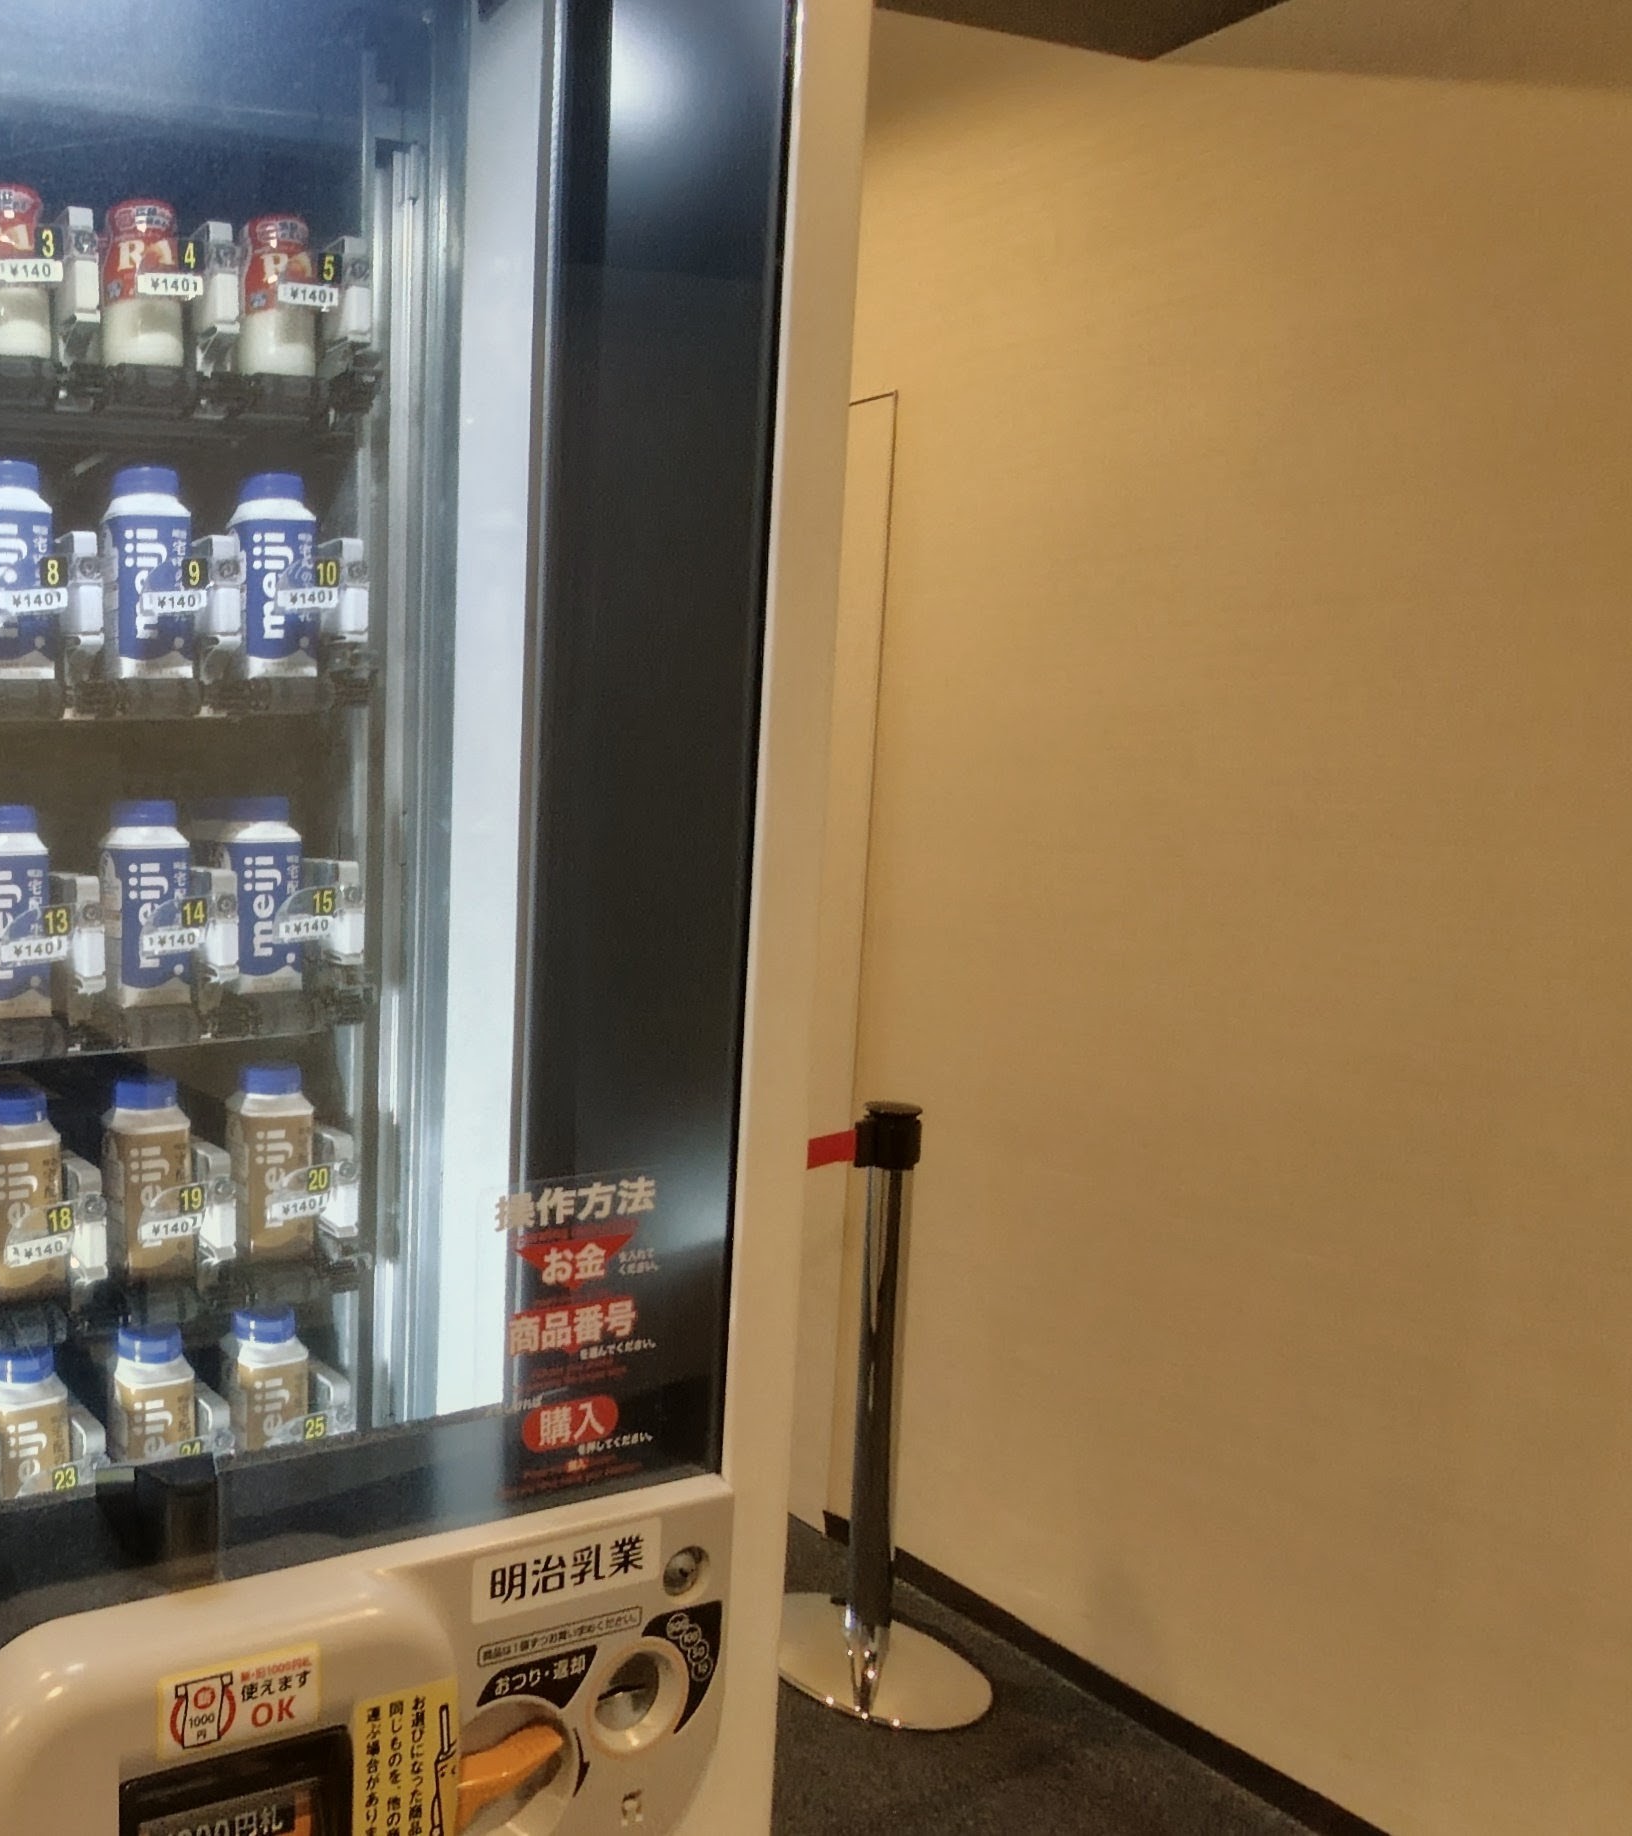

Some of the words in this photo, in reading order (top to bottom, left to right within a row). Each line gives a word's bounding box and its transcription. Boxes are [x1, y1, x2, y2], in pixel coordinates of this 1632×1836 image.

[41, 229, 55, 259] 3
[183, 241, 196, 270] 4
[322, 255, 335, 282] 5
[45, 558, 59, 587] 8
[187, 560, 201, 587] 9
[316, 560, 338, 587] 10
[182, 900, 206, 927] 14
[244, 855, 283, 957] meiji
[312, 888, 334, 915] 15
[43, 907, 68, 936] 13
[306, 1168, 329, 1192] 20
[180, 1186, 204, 1211] 19
[494, 1175, 656, 1232] 操作方法
[48, 1207, 73, 1233] 18
[541, 1242, 607, 1286] お金
[508, 1299, 637, 1357] 商品番号
[305, 1417, 325, 1439] 25
[538, 1401, 606, 1447] 購入
[53, 1467, 76, 1491] 23
[489, 1533, 645, 1603] 明治乳業
[240, 1670, 312, 1703] 使えます
[188, 1713, 216, 1729] 1000
[251, 1695, 298, 1729] OK
[196, 1729, 207, 1741] 円
